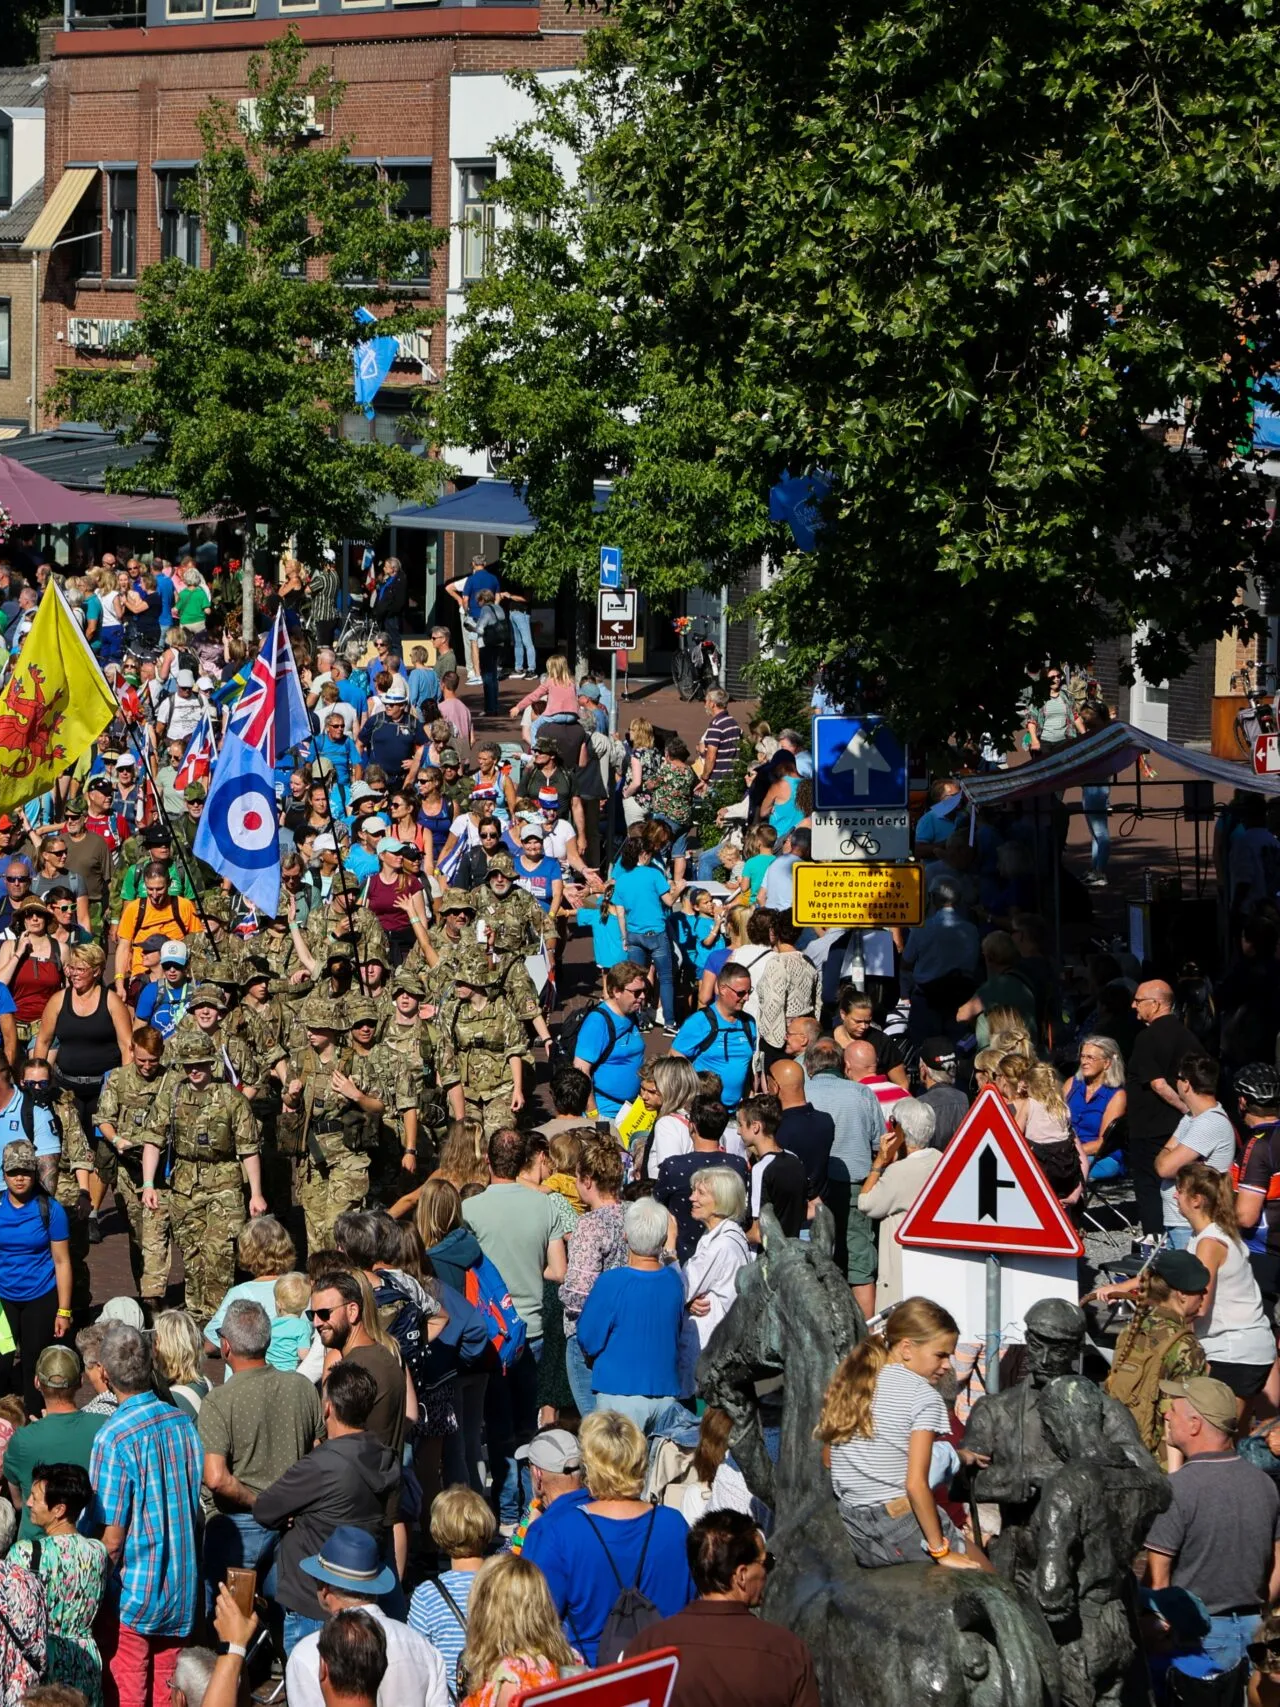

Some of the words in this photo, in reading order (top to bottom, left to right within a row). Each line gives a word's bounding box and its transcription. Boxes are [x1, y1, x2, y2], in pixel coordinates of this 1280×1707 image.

[69, 318, 98, 345] HET
[814, 815, 907, 828] uitgezonderd
[813, 880, 845, 888] iedere
[813, 890, 875, 899] Dorpsstraat
[808, 901, 910, 910] Wagenmakersstraat
[810, 911, 865, 921] afgesloten
[868, 912, 883, 920] tot
[900, 912, 906, 920] h
